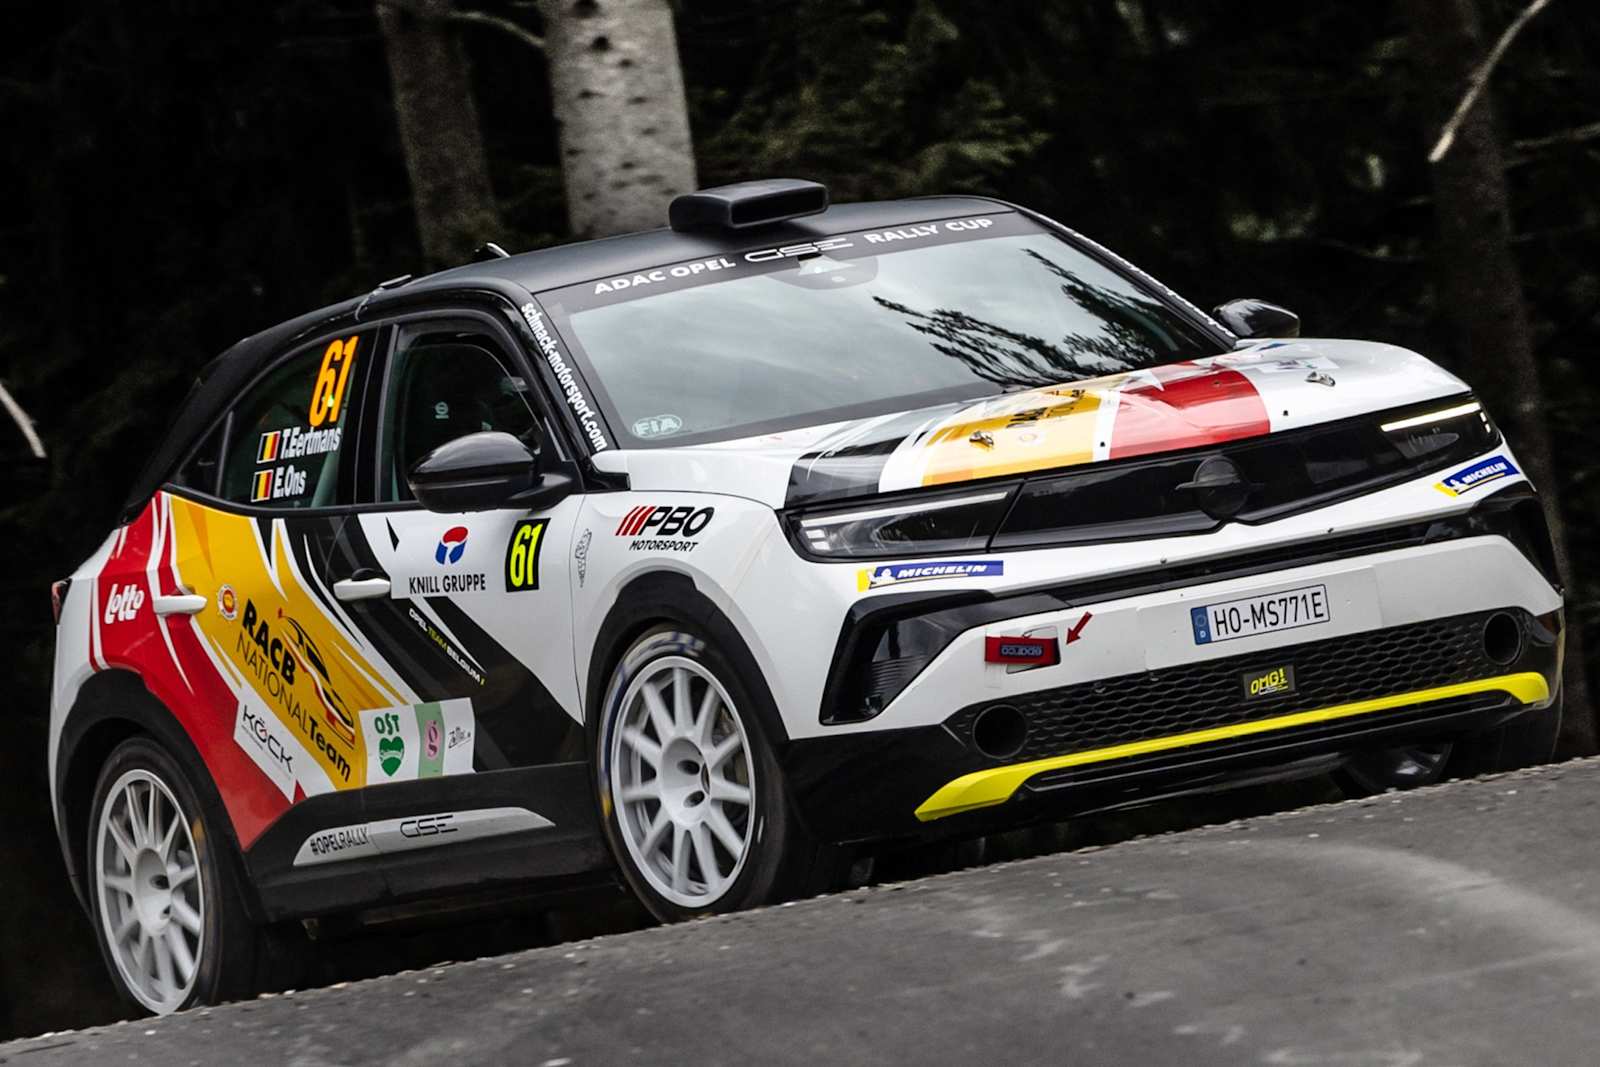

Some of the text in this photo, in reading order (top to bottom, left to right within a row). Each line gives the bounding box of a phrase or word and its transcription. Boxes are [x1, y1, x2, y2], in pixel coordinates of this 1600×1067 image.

[594, 271, 667, 294] ADAC
[670, 257, 737, 278] OPEL
[863, 224, 939, 244] RALLY
[945, 218, 993, 232] CUP
[309, 335, 360, 427] 61
[633, 416, 679, 436] FIA
[280, 426, 342, 460] T.Eertmans
[273, 464, 307, 499] E.Ons
[1461, 462, 1508, 484] MICHELIN
[637, 506, 715, 537] PBO
[509, 523, 544, 587] 61
[629, 540, 699, 553] MOTORSPORT
[409, 573, 486, 594] KNILL GRUPPE
[897, 564, 988, 579] MICHELIN
[1213, 591, 1325, 637] HO-MS771E
[242, 598, 295, 686] RACB
[1250, 667, 1289, 695] OMG!
[374, 712, 400, 735] OST
[400, 814, 458, 838] GSE
[310, 827, 369, 856] #OPELRALLY
